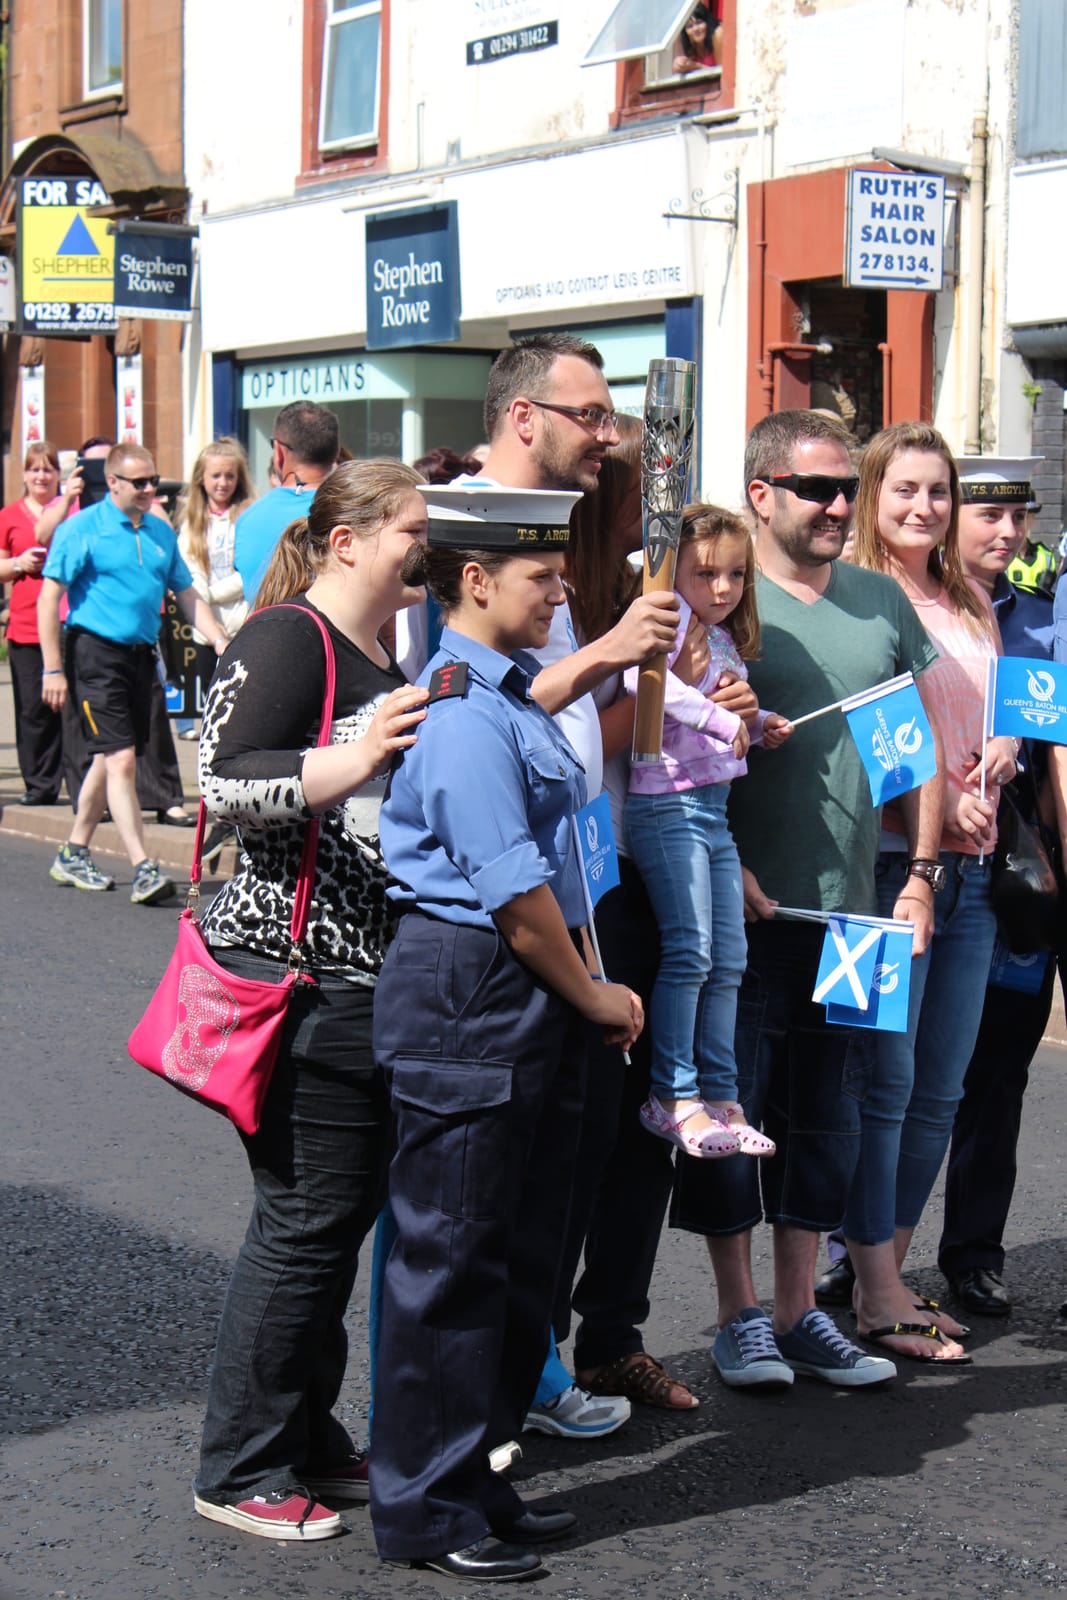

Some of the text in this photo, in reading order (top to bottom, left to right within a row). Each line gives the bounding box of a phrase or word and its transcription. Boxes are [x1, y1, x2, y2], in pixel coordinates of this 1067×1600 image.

[489, 34, 518, 55] 01294
[23, 181, 111, 205] FOR SA
[860, 177, 937, 199] RUTH'S
[870, 202, 926, 222] HAIR
[860, 225, 936, 247] SALON
[32, 257, 112, 274] SHEPHER
[120, 254, 188, 278] Stephen
[373, 252, 443, 298] Stephen
[127, 273, 175, 294] Rowe
[496, 266, 681, 303] OPTICIANS AND CONTACT LENS CENTRE
[24, 303, 71, 320] 01292
[75, 303, 115, 320] 2679
[381, 295, 430, 328] Rowe
[251, 363, 366, 399] OPTICIANS
[1003, 698, 1067, 714] QUEEN'S BATON REL
[875, 708, 891, 739] QUEEN'S
